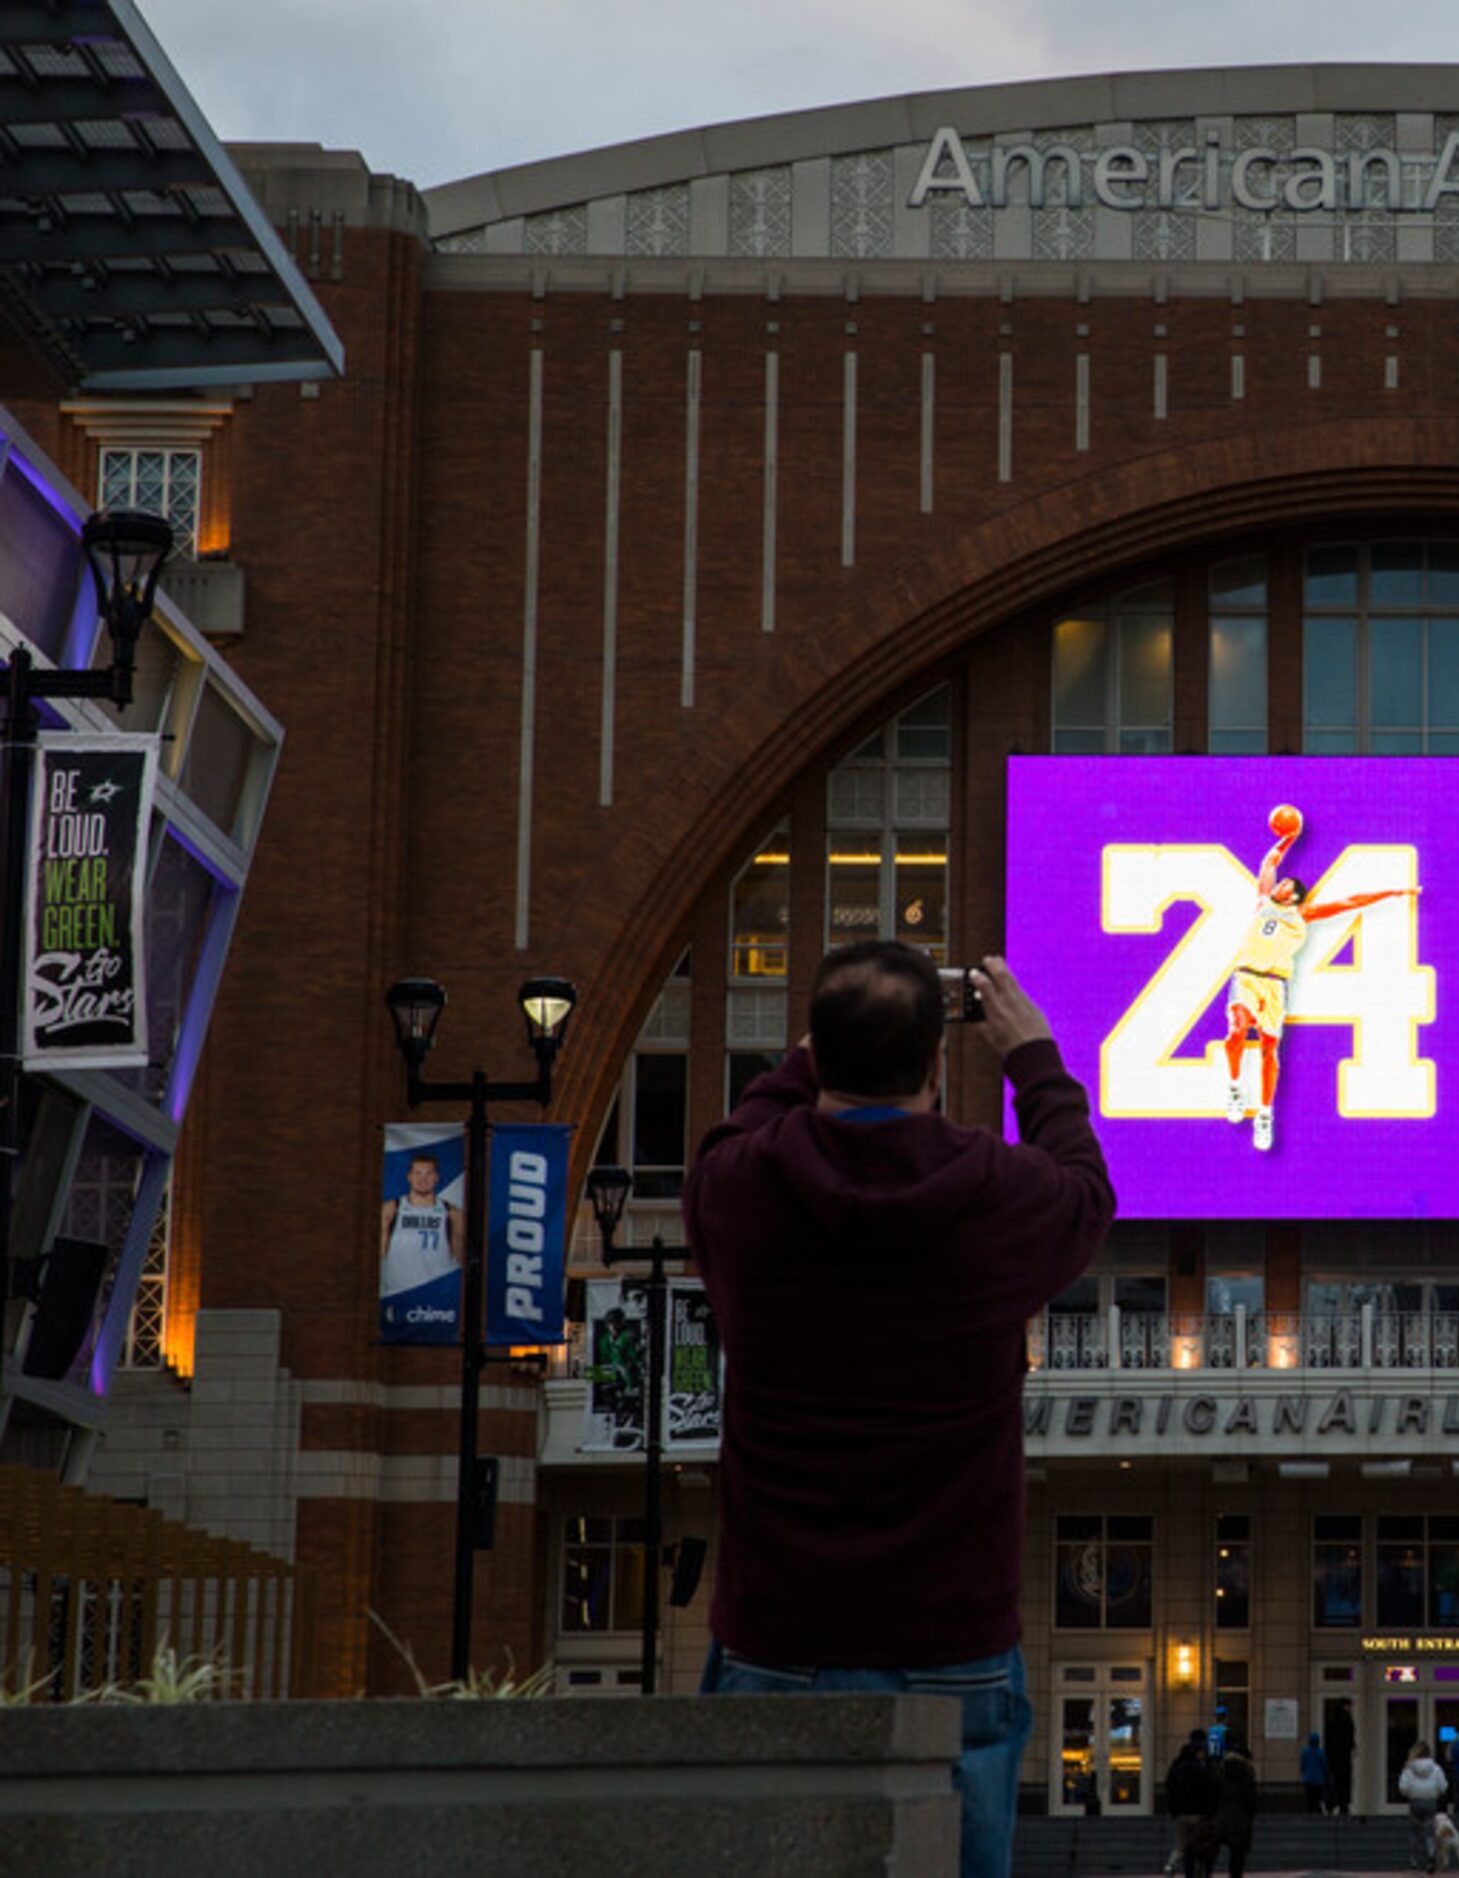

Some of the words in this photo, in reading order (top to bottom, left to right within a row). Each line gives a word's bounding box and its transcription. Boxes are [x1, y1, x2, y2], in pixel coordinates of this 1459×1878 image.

[51, 770, 81, 813] BE
[47, 814, 109, 858] LOUD.
[44, 859, 107, 903] WEAR
[43, 904, 120, 950] GREEN.
[1262, 919, 1278, 936] 8
[85, 947, 122, 987] Go
[1100, 843, 1436, 1118] 24
[34, 952, 134, 1031] Stars
[418, 1230, 439, 1250] 77
[504, 1149, 549, 1322] PROUD
[406, 1304, 457, 1323] chime
[1361, 1637, 1410, 1651] SOUTH
